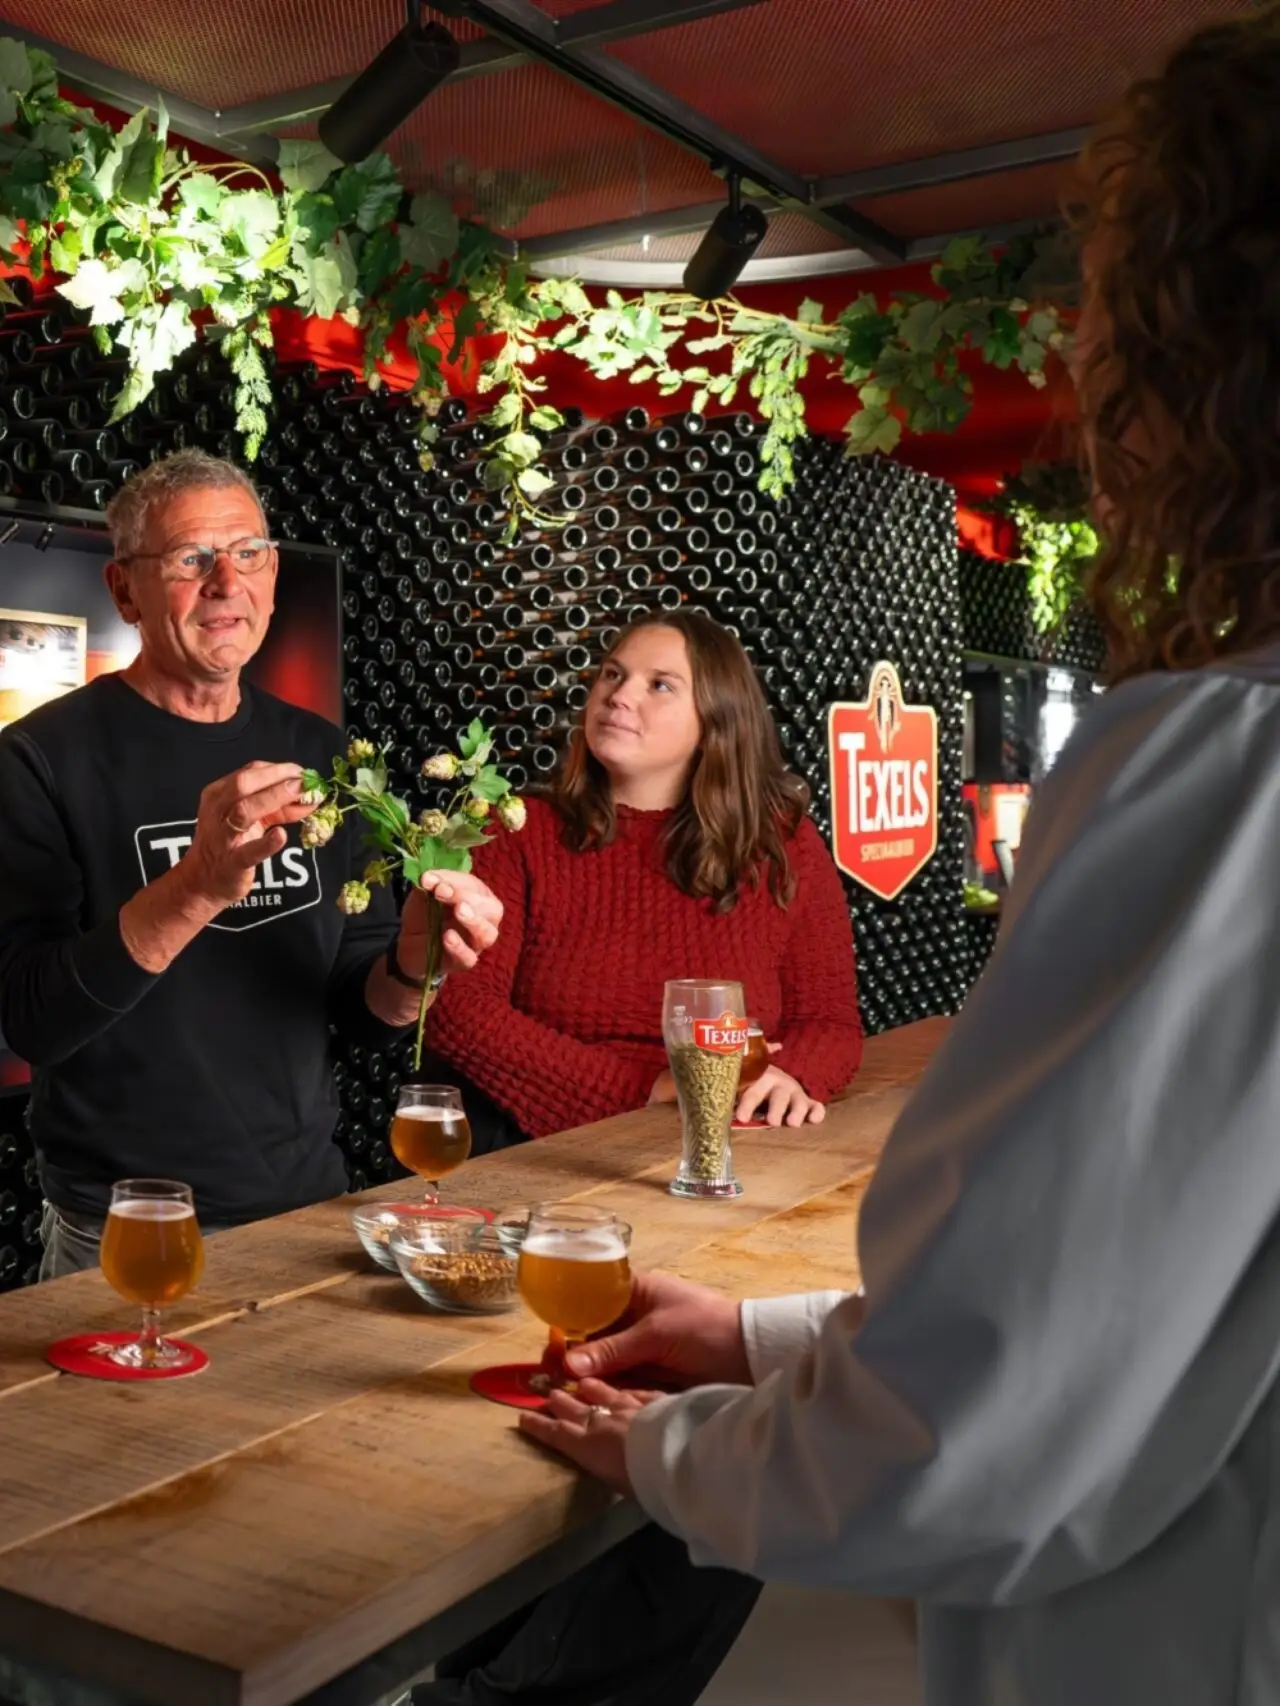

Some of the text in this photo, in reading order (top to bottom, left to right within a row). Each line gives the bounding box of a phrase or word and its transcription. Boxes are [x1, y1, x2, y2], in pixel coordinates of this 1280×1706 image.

[838, 732, 930, 834] TEXELS
[149, 836, 310, 889] TLS
[698, 1024, 748, 1045] TEXELS
